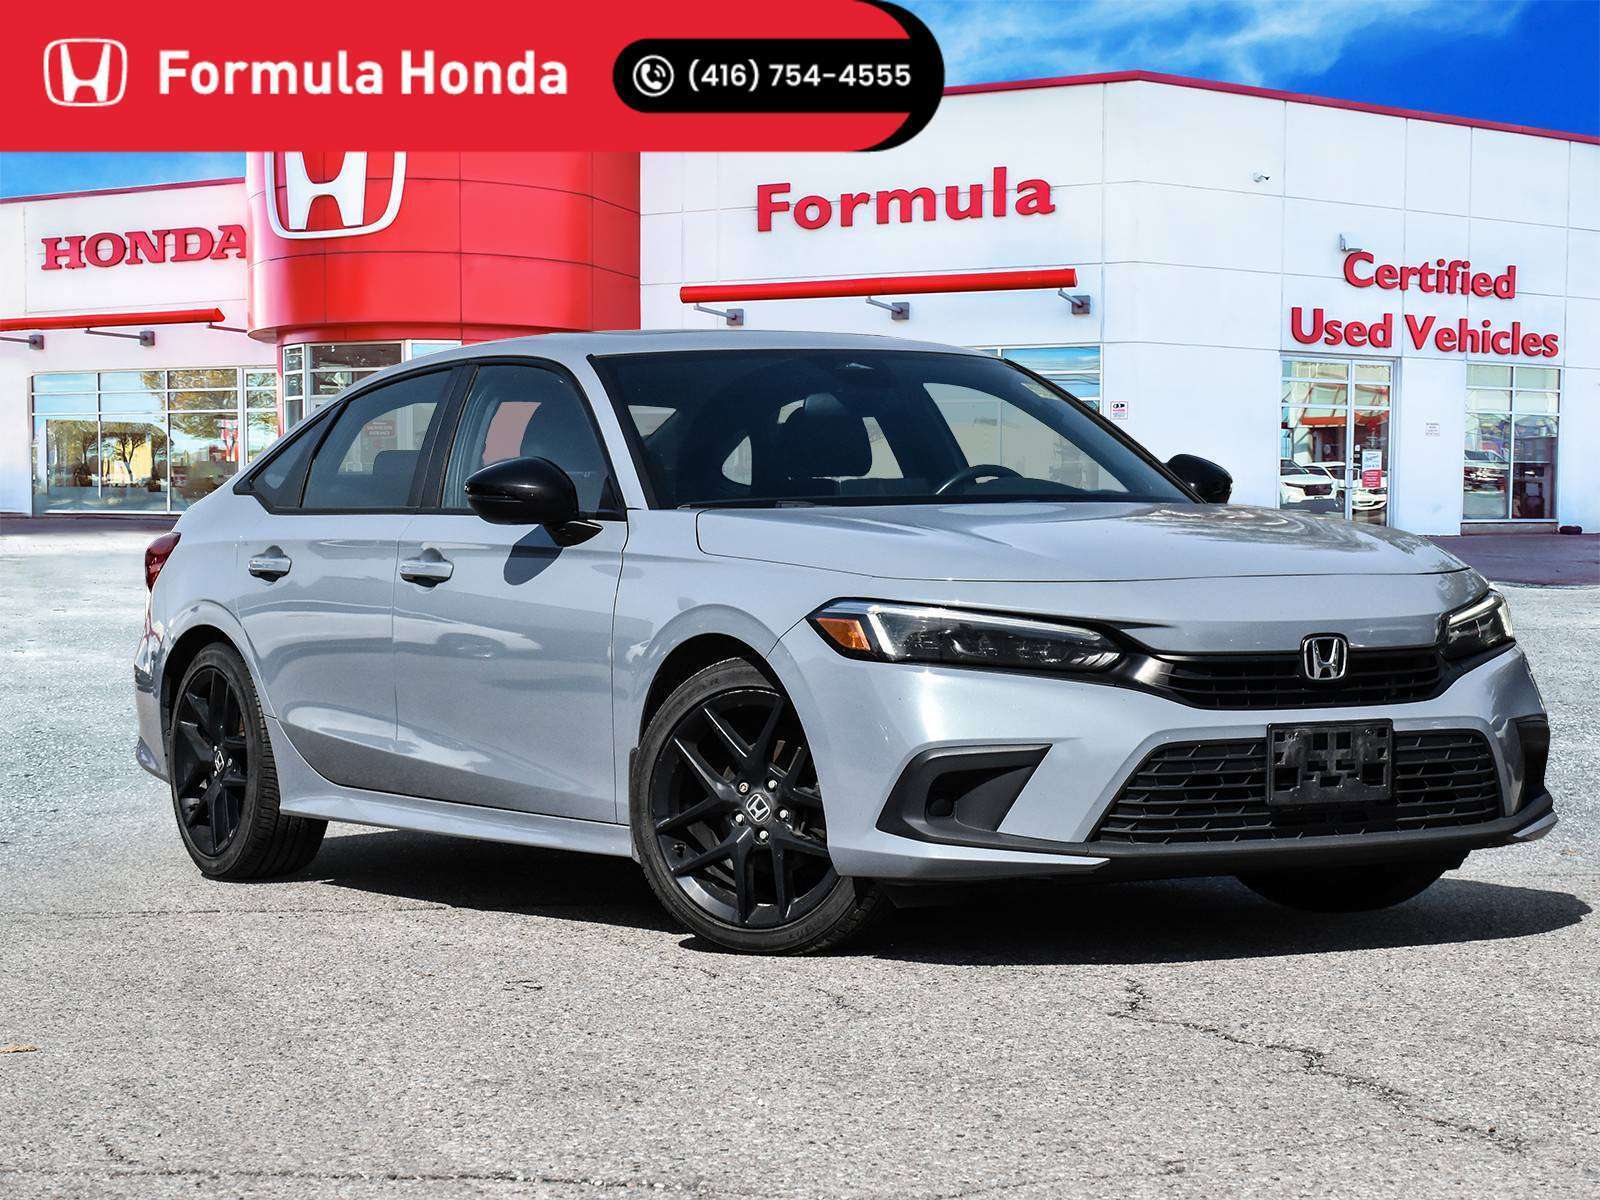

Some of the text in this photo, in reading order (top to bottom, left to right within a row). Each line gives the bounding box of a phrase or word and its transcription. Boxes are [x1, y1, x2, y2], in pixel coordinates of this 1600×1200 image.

[757, 166, 1056, 233] Formula
[41, 224, 247, 271] HONDA
[1342, 250, 1517, 300] Certified
[1290, 306, 1560, 358] Used Vehicles
